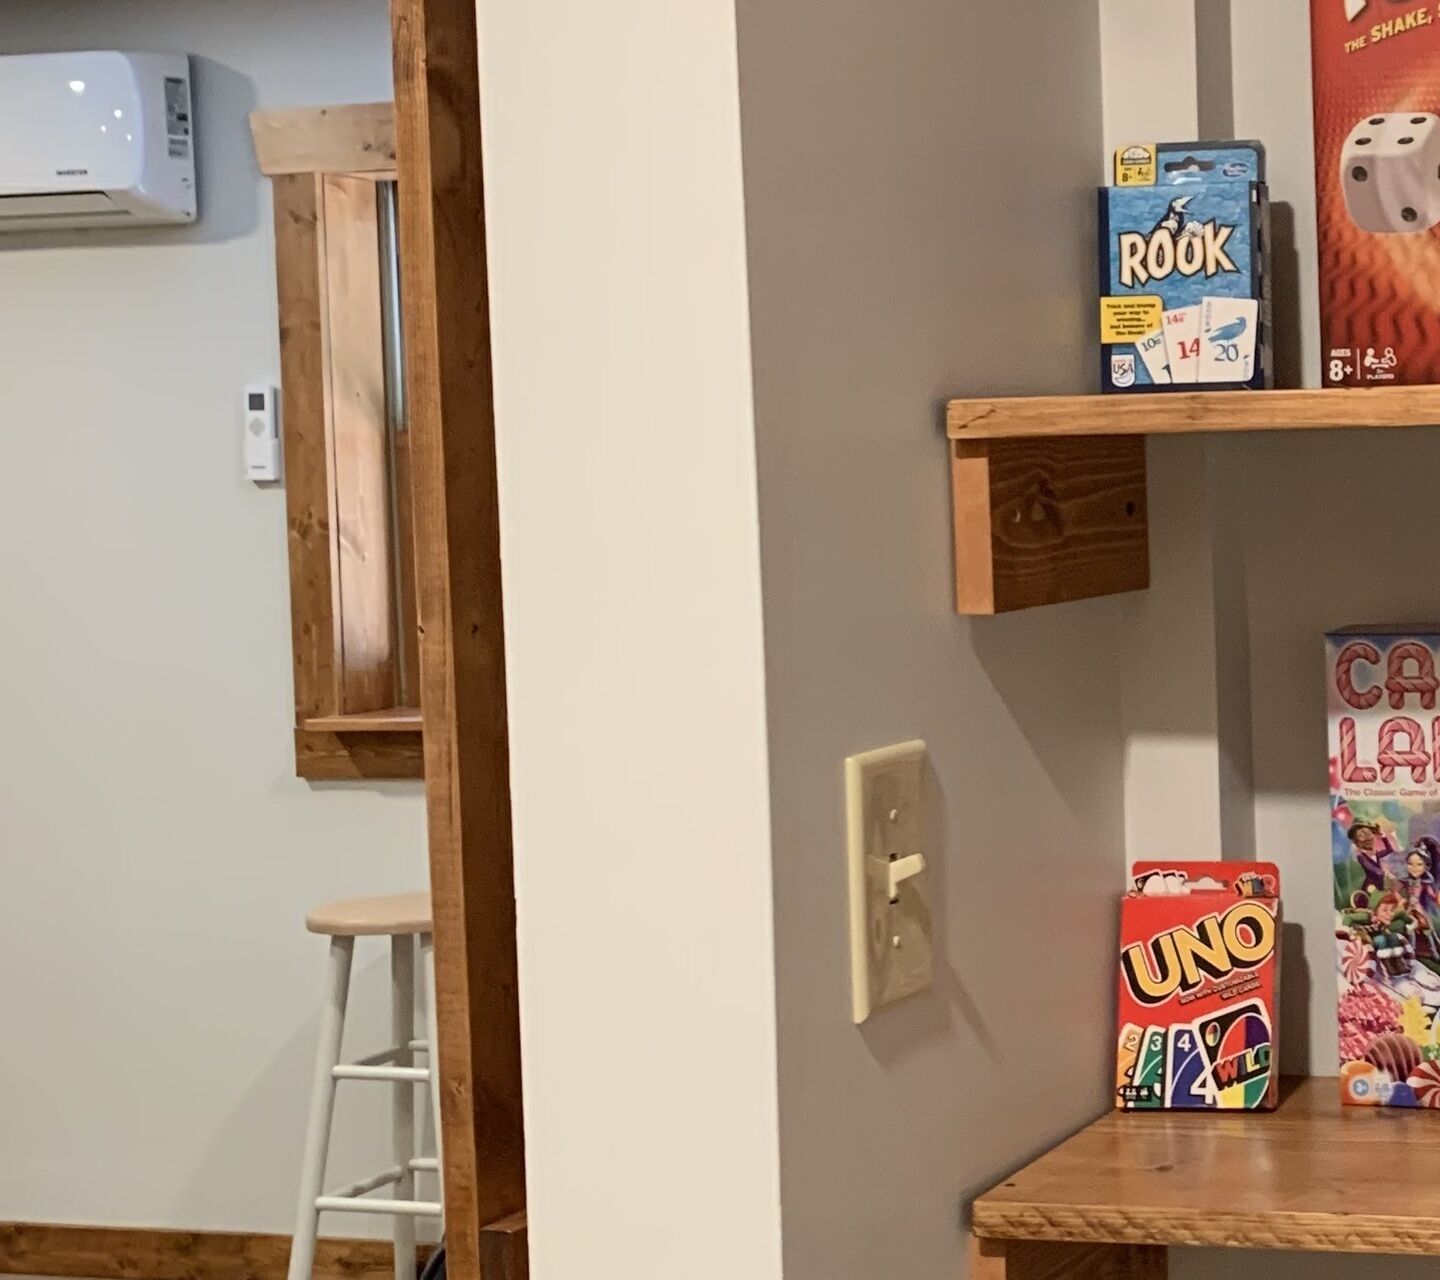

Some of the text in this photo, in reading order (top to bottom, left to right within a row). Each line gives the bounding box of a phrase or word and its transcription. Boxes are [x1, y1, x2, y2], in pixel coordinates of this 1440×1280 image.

[1344, 36, 1367, 54] THE
[1370, 7, 1433, 44] SHAKE,
[1118, 218, 1241, 289] ROOK
[1177, 337, 1200, 360] 14
[1214, 343, 1239, 362] 20
[1113, 363, 1134, 377] USA
[1329, 359, 1353, 381] 8+
[1344, 788, 1361, 796] The
[1363, 787, 1396, 796] Classic
[1400, 787, 1426, 796] Game
[1429, 787, 1438, 796] of
[1124, 902, 1275, 1002] UNO
[1124, 1030, 1139, 1051] 2
[1150, 1035, 1163, 1051] 3
[1177, 1033, 1192, 1052] 4
[1214, 1043, 1271, 1085] WILD
